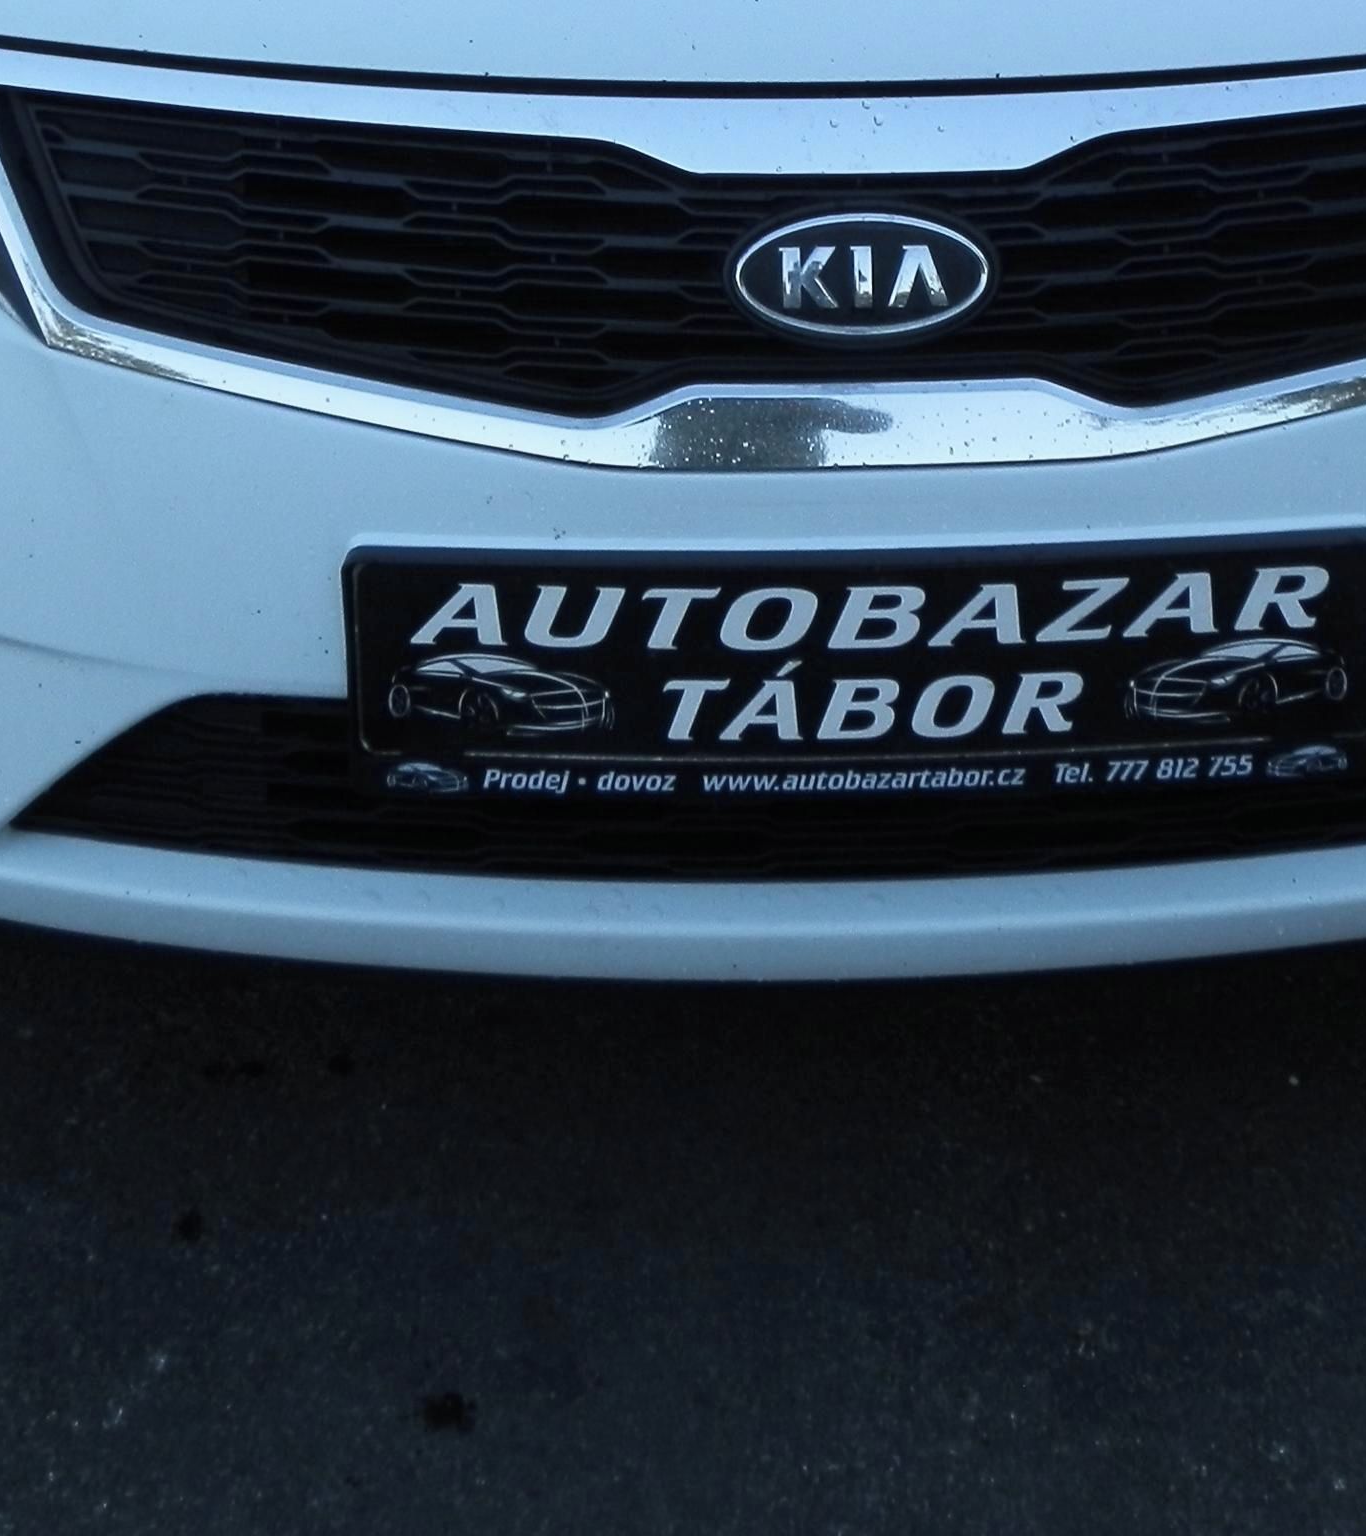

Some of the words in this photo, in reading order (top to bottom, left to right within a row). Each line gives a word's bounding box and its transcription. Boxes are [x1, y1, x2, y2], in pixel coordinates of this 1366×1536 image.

[778, 244, 950, 309] KIA
[409, 565, 1332, 651] AUTOBAZAR
[662, 658, 1085, 743] TÁBOR
[483, 768, 570, 795] Prodej
[597, 770, 677, 793] dovoz
[702, 767, 1026, 793] www.autobazartabor.cz
[1053, 762, 1094, 784] Tel.
[1106, 759, 1150, 782] 777
[1156, 757, 1199, 780] 812
[1208, 754, 1254, 777] 755
